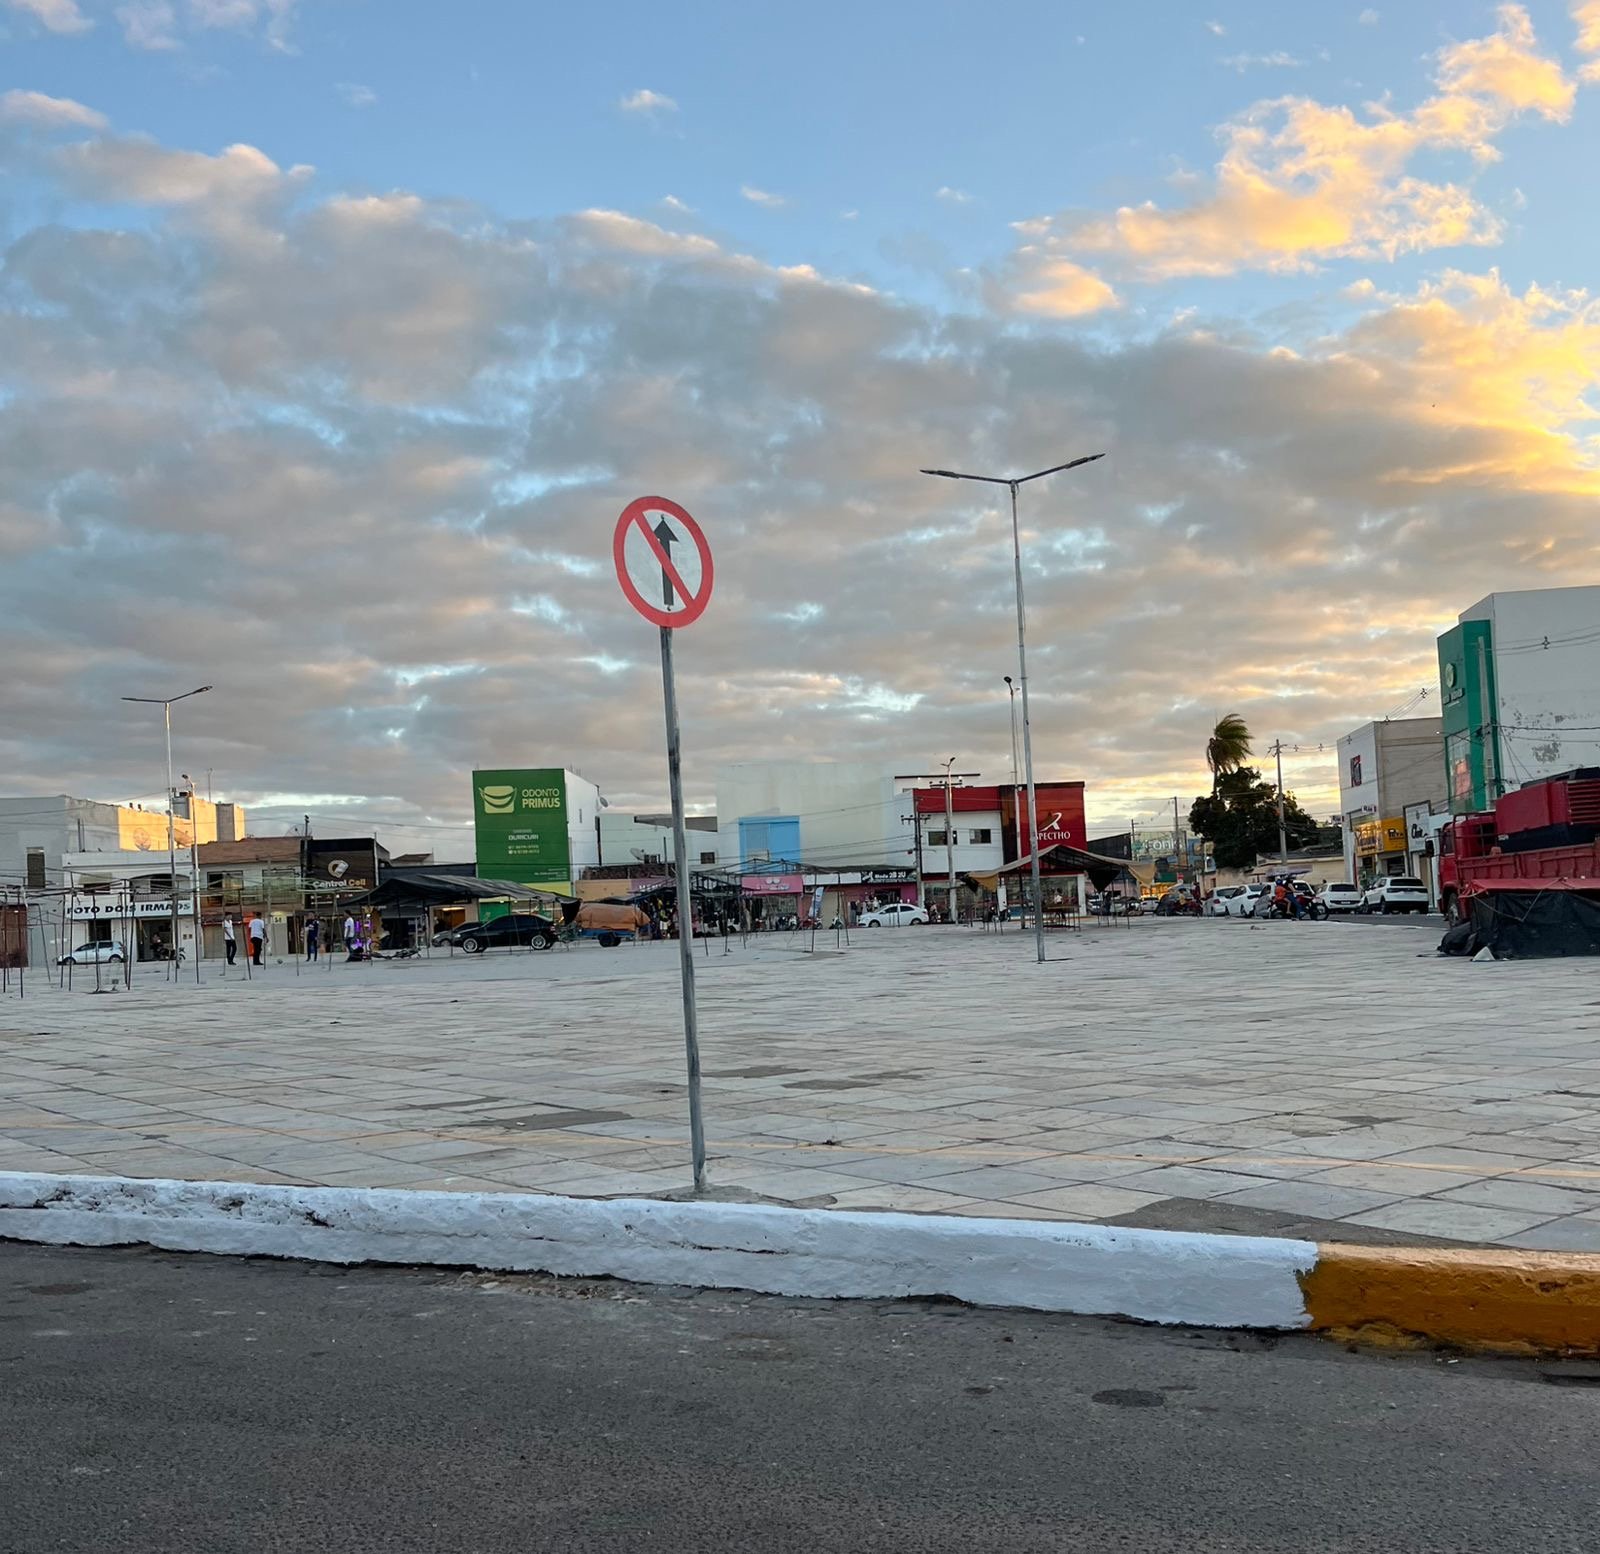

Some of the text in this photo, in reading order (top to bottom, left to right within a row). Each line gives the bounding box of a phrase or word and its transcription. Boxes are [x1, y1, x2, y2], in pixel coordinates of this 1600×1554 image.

[522, 788, 560, 798] ODONTO
[522, 798, 561, 808] PRIMUS
[67, 905, 100, 915] FOTO
[105, 904, 136, 913] DOIS
